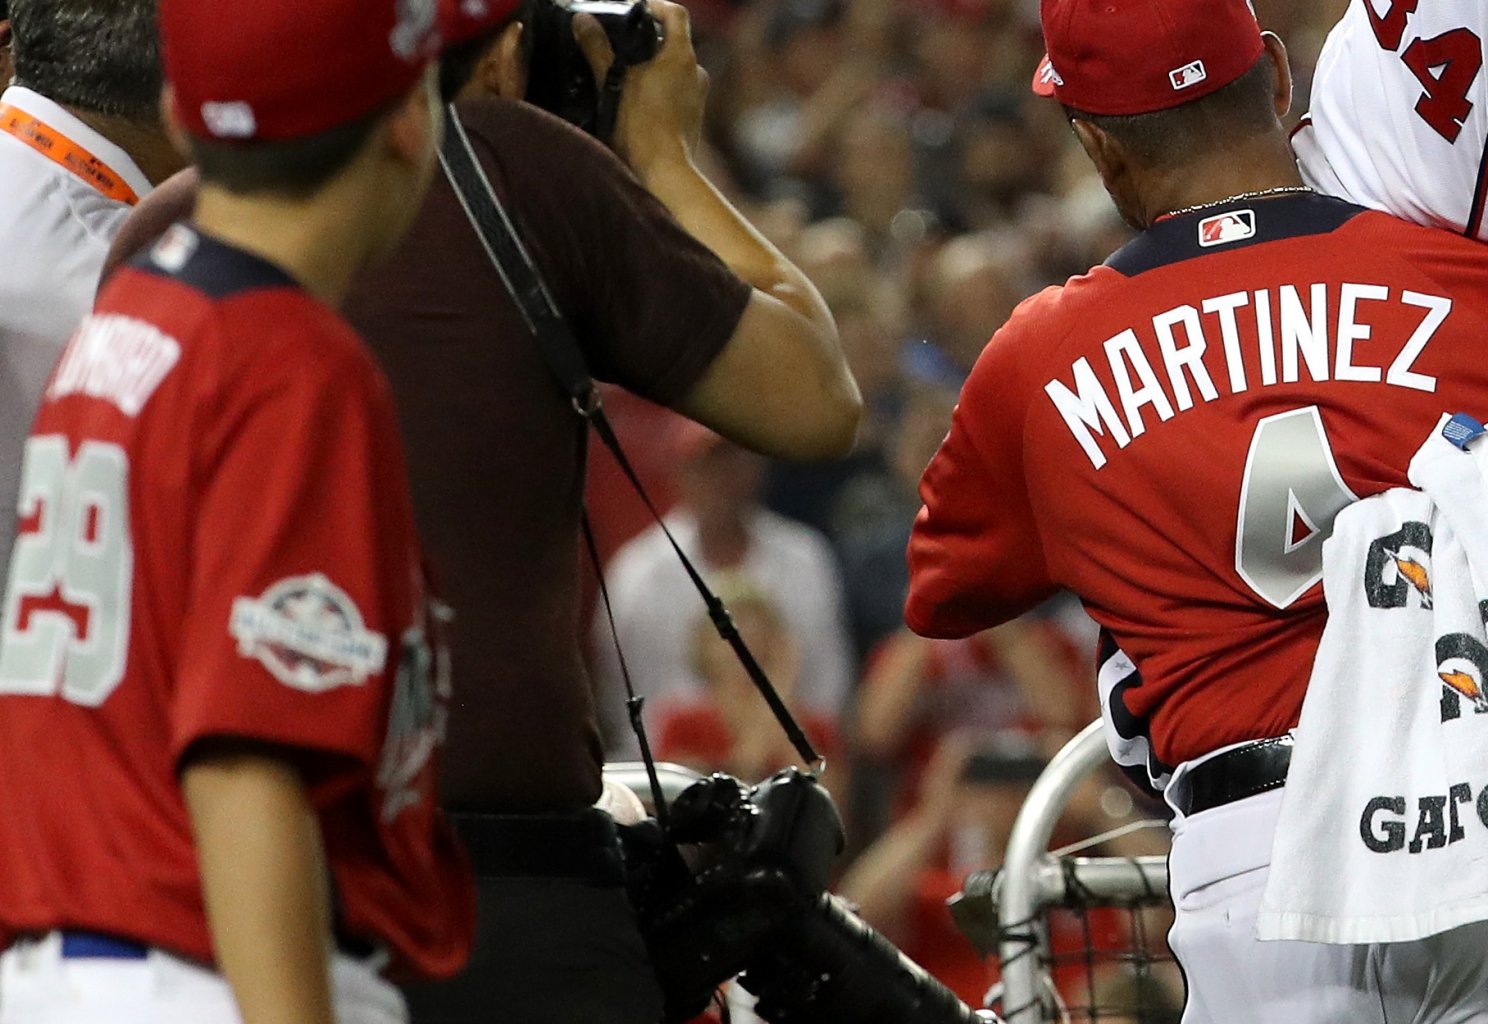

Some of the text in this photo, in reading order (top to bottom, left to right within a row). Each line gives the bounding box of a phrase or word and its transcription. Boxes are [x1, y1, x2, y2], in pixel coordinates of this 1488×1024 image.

[1043, 282, 1453, 471] MARTINEZ
[0, 433, 134, 708] 29
[1234, 404, 1360, 611] 4
